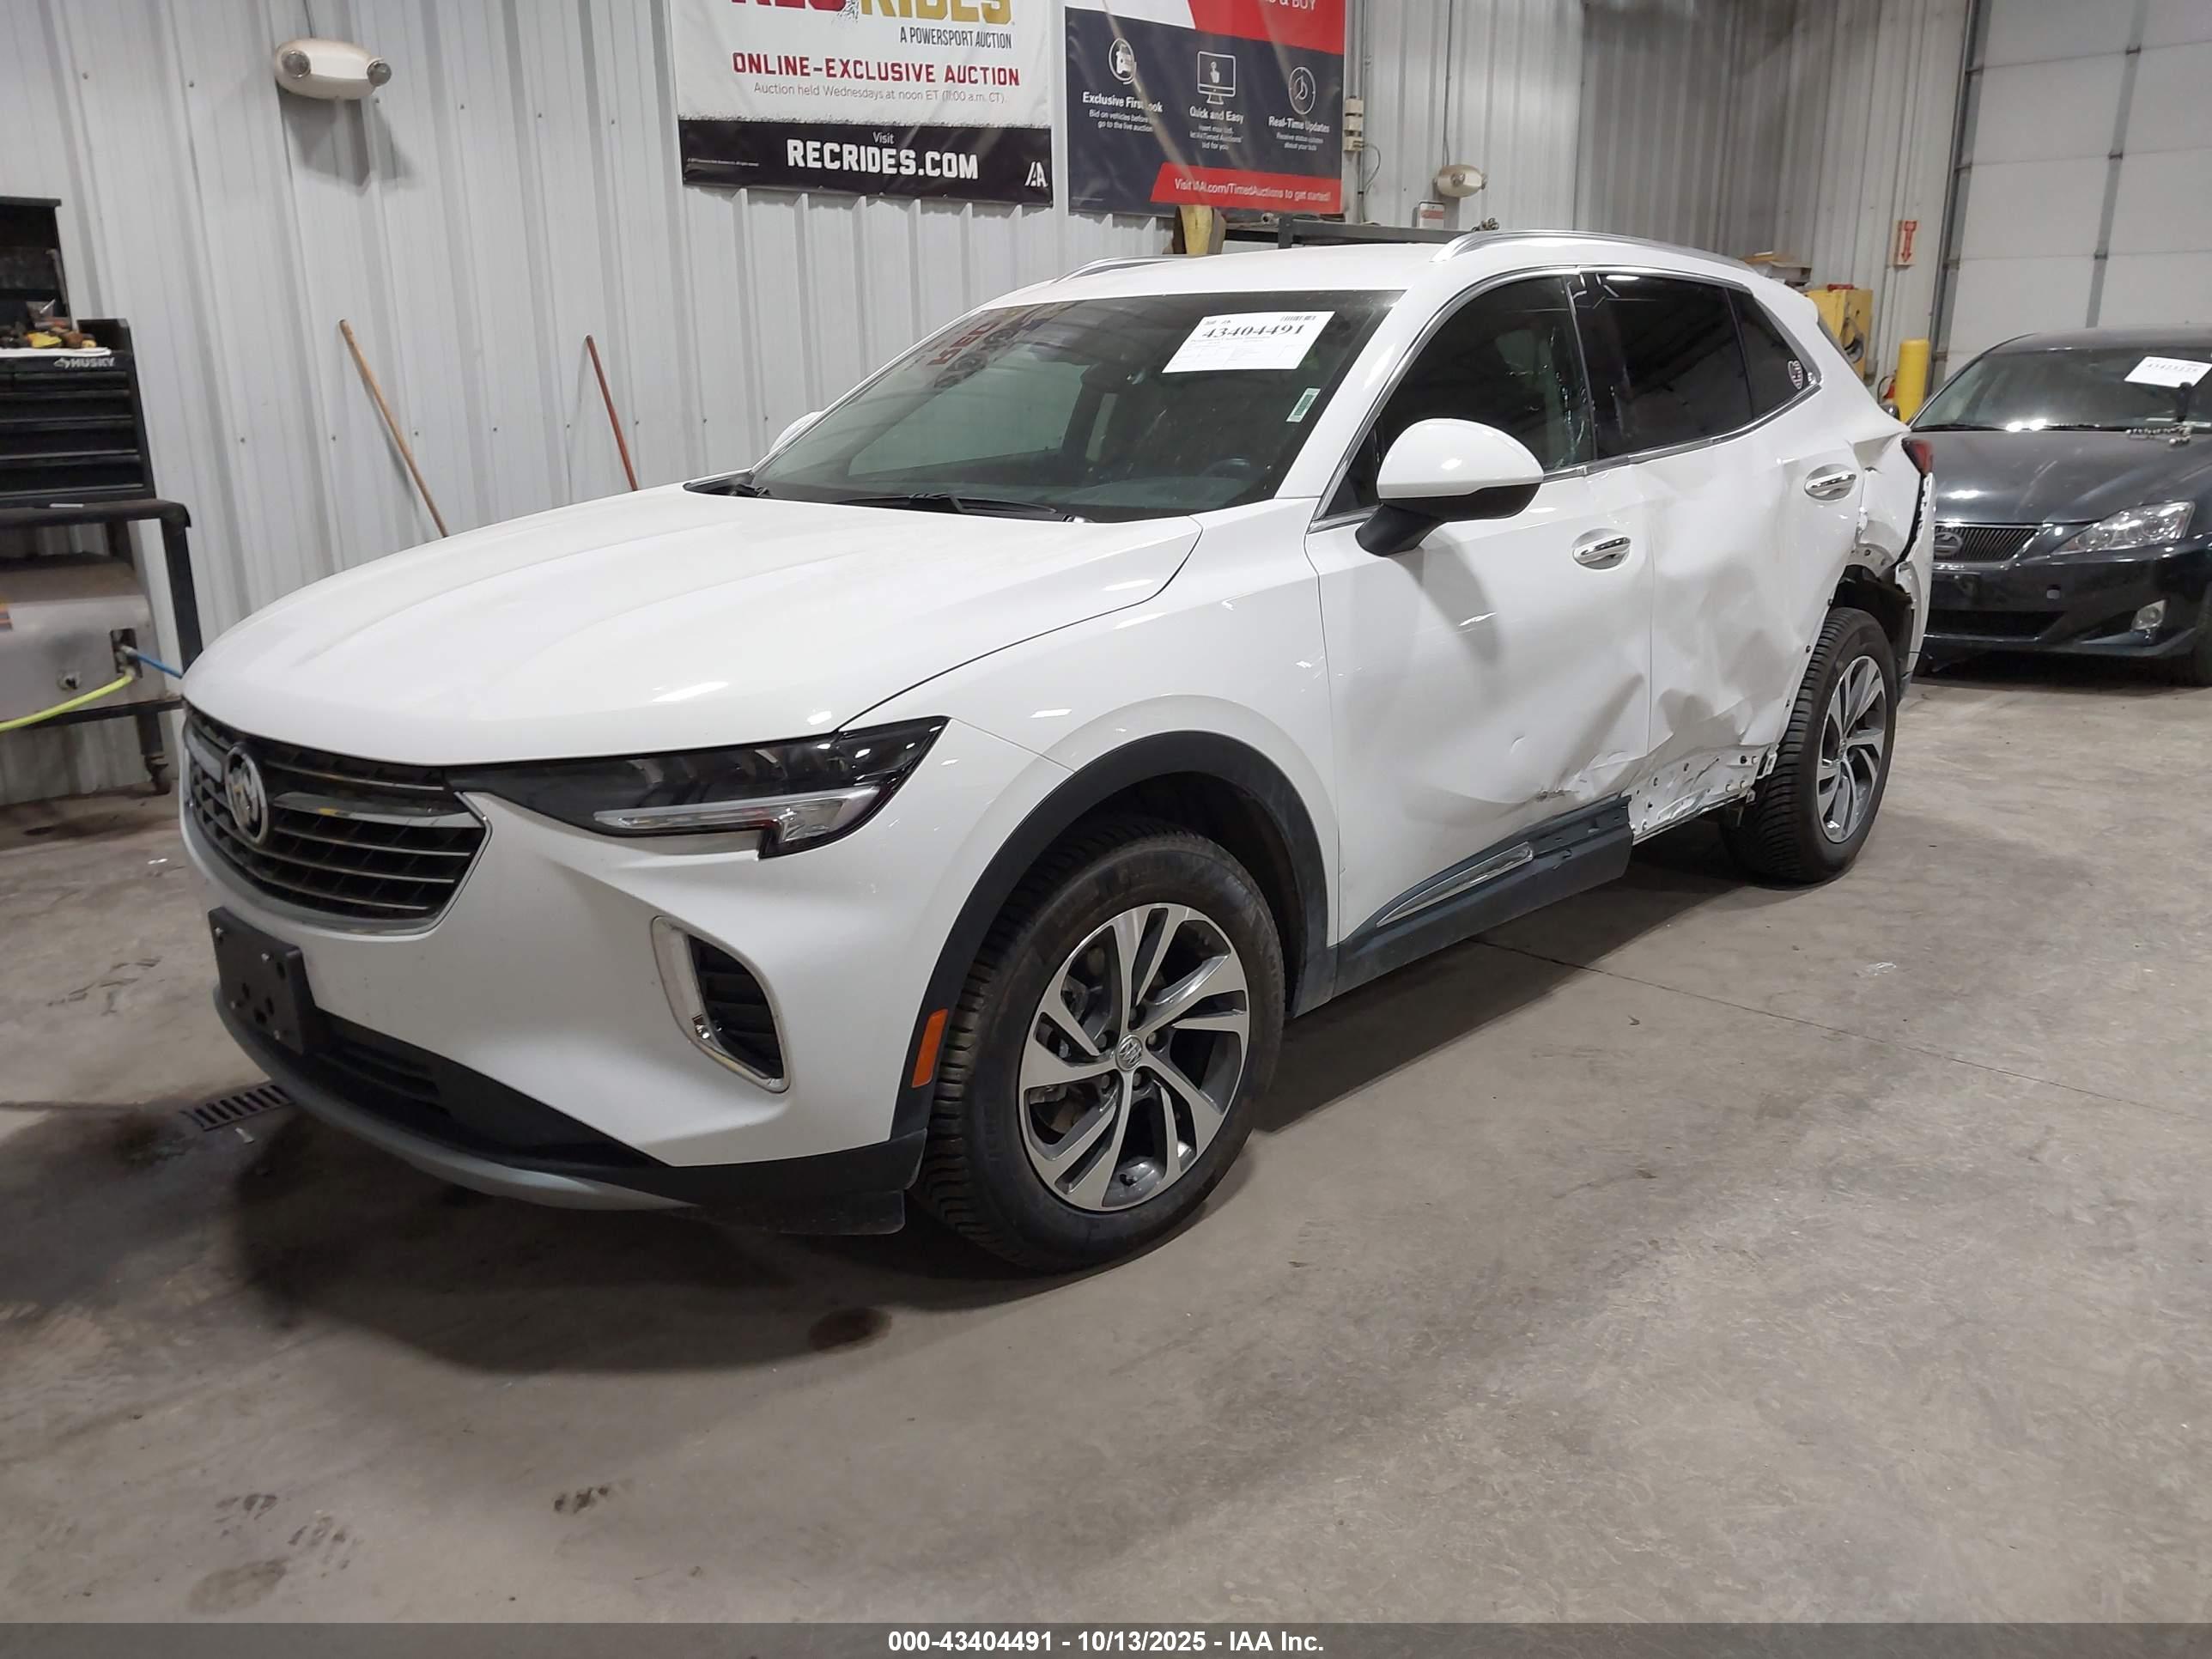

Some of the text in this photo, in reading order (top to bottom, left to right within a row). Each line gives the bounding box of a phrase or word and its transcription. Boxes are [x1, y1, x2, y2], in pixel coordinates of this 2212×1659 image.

[900, 26, 1012, 49] A POWERSPORT AUCTION
[732, 52, 1020, 86] ONLINE-EXCLUSIVE AUCTION
[754, 82, 795, 95] Auction
[797, 85, 820, 96] held
[823, 87, 884, 100] Wednesdays
[884, 90, 895, 100] at
[898, 91, 924, 100] noon
[926, 89, 939, 101] ET
[1082, 91, 1163, 112] Exclusive Firs ook
[1089, 109, 1099, 118] Bid
[1189, 105, 1244, 124] Quick and Easy
[1268, 115, 1330, 133] Real-Time Updates
[872, 131, 894, 145] Visit
[787, 139, 979, 179] RECRIDES.COM
[1175, 178, 1192, 191] Visit
[1285, 189, 1292, 198] to
[1202, 325, 1304, 337] 43404491
[70, 357, 115, 368] HUSKY
